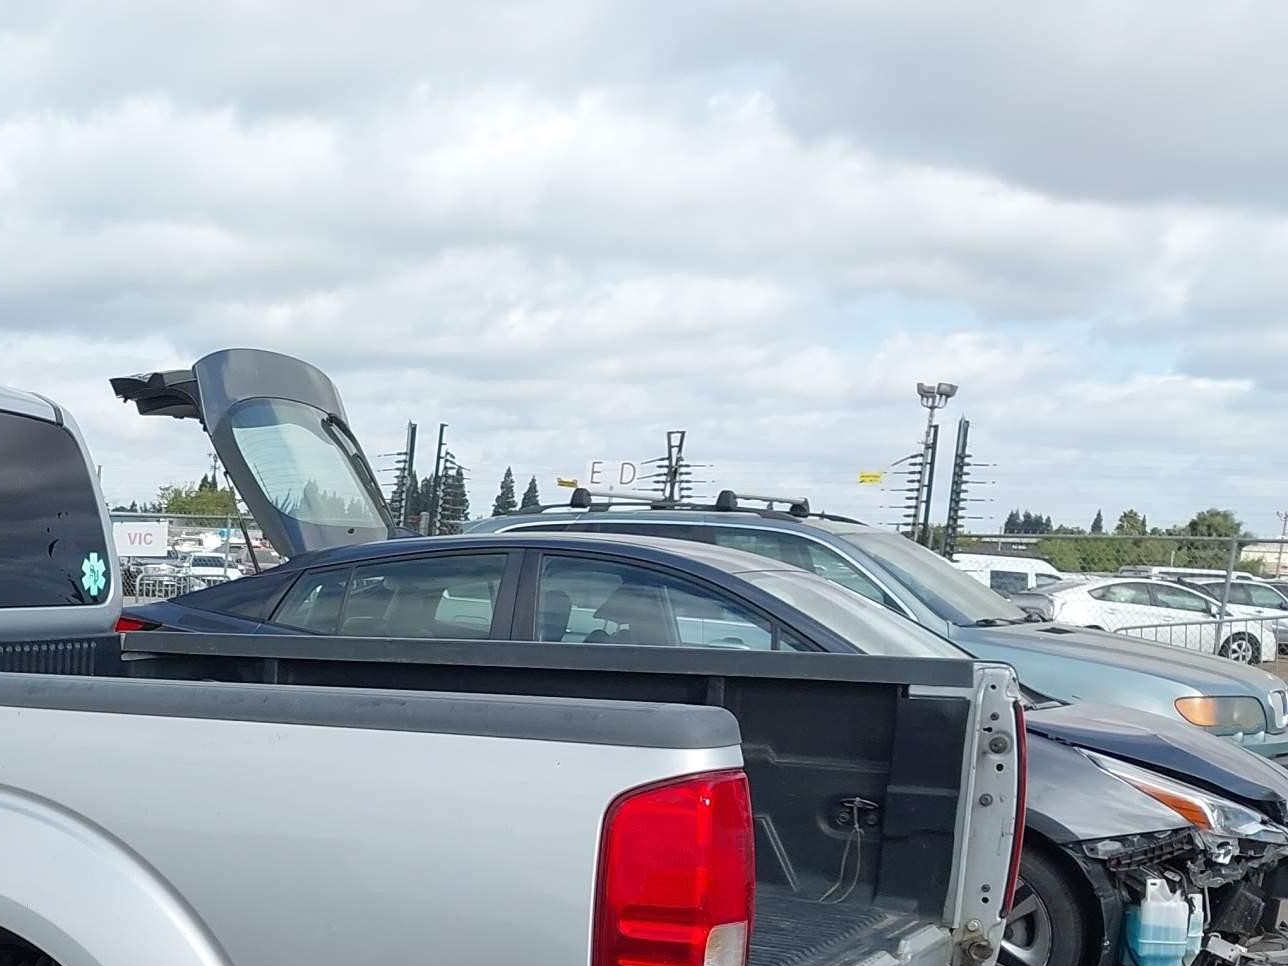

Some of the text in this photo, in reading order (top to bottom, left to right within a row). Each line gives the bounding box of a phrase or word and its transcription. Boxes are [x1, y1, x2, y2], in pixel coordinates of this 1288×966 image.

[590, 461, 636, 484] E D
[127, 532, 153, 546] VIC
